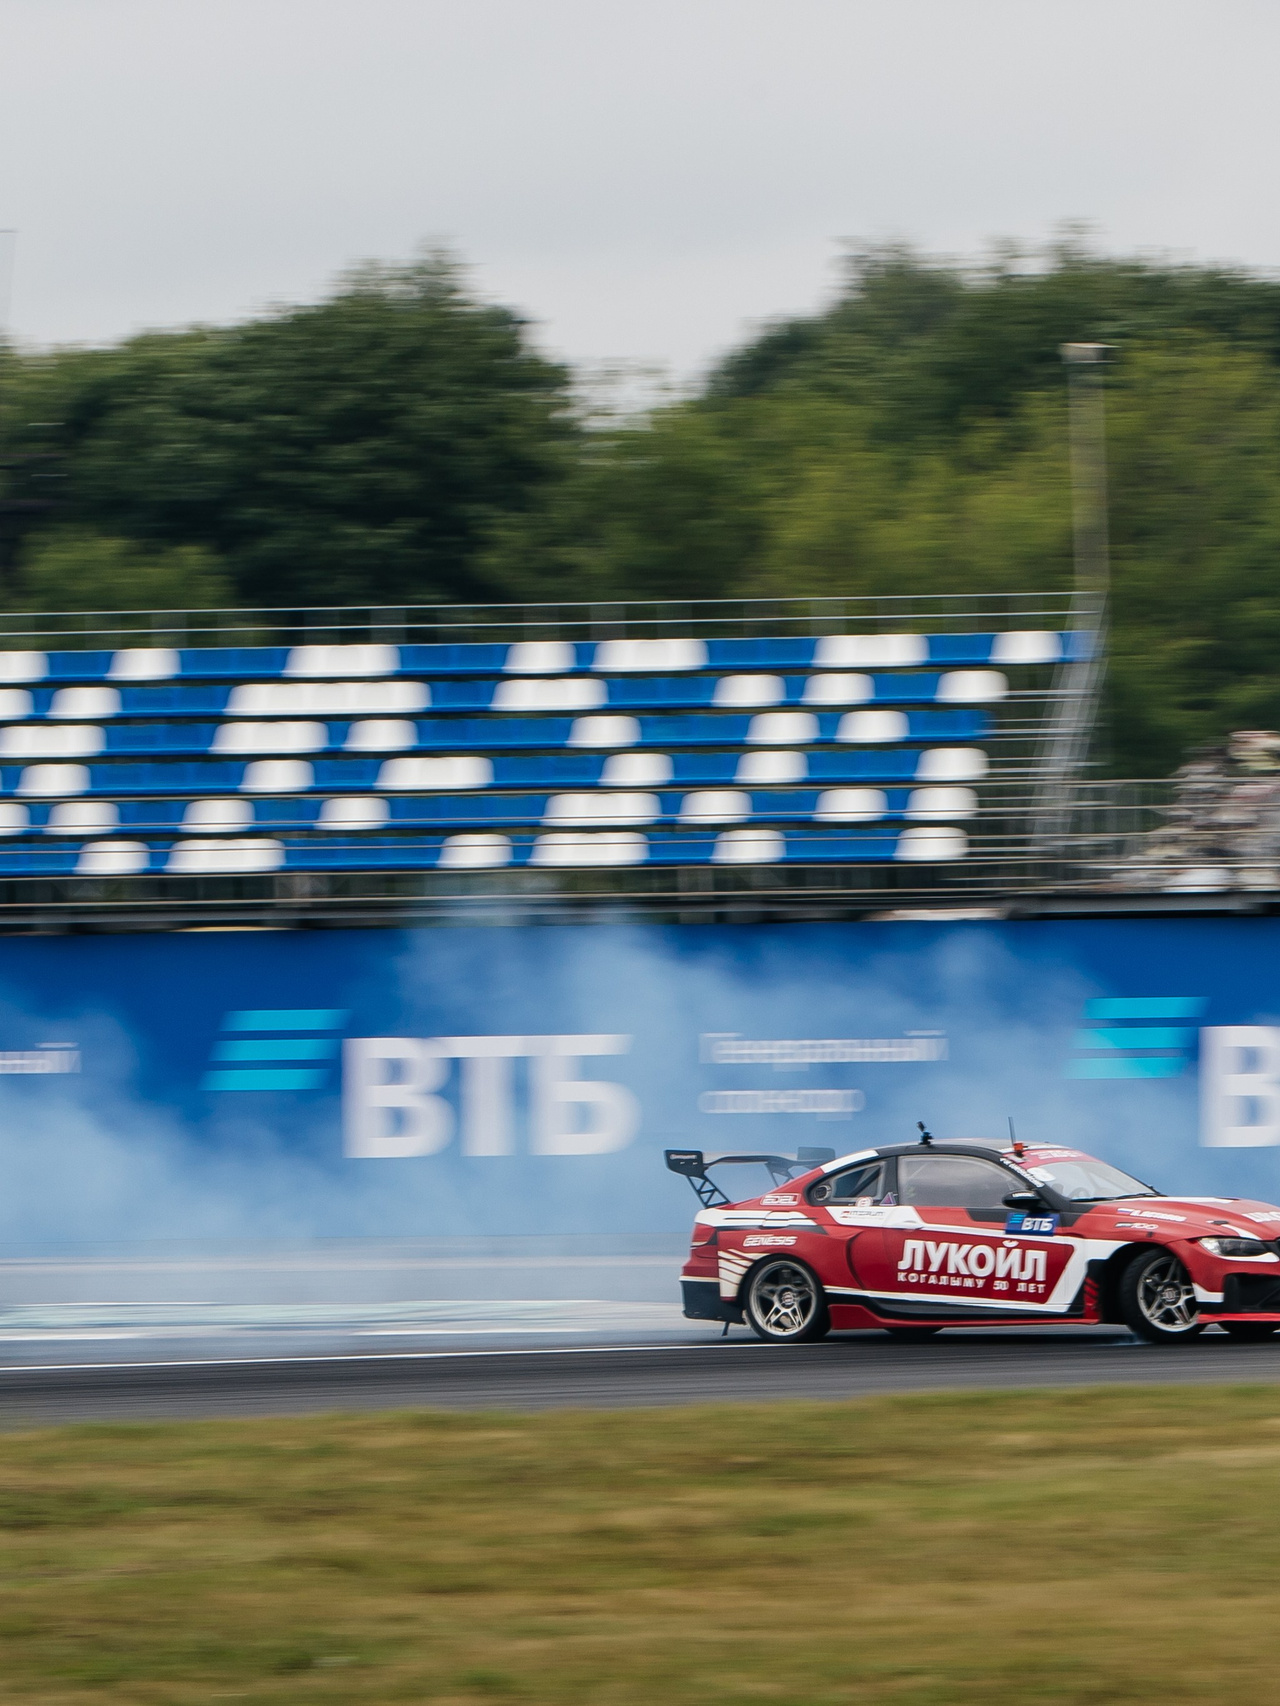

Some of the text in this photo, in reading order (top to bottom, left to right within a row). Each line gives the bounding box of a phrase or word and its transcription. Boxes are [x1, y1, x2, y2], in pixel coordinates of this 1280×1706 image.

[342, 1034, 642, 1159] ВТБ
[1021, 1217, 1054, 1231] ВТБ
[743, 1235, 798, 1247] GENESIS
[897, 1239, 1048, 1281] ЛУКОЙЛ
[1016, 1282, 1047, 1293] ЛЕТ
